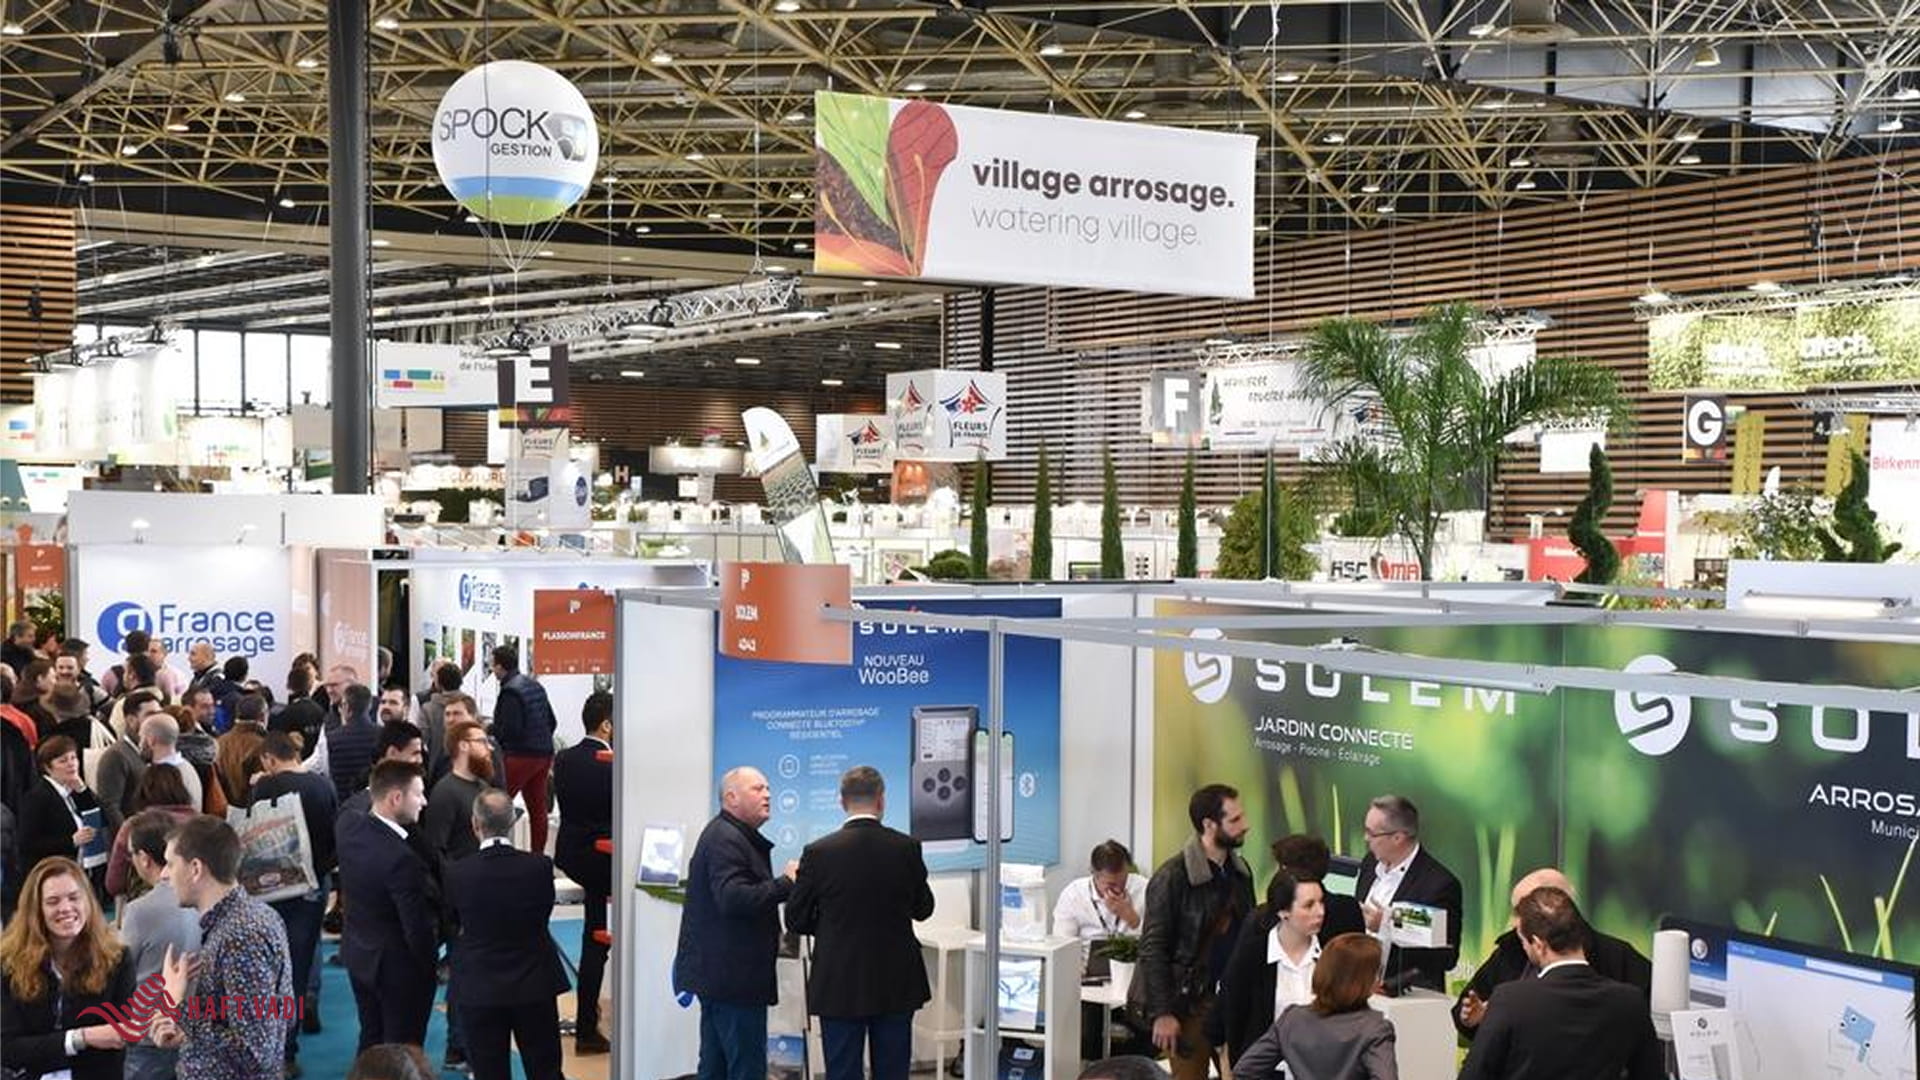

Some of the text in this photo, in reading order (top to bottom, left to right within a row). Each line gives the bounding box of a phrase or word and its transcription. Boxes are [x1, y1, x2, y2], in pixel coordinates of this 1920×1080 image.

[440, 107, 550, 141] SPOCK
[491, 143, 552, 157] GESTION
[973, 159, 1235, 212] village arrosage.
[971, 204, 1202, 250] watering village.
[514, 346, 554, 403] E
[1163, 377, 1190, 429] F
[953, 421, 988, 431] FLEURS
[1687, 399, 1724, 446] G
[614, 465, 629, 483] H
[159, 603, 275, 633] France
[858, 667, 930, 685] WooBee
[863, 654, 925, 668] NOUVEAU
[1255, 716, 1316, 739] JARDIN
[1254, 736, 1292, 753] Arrosage
[1300, 742, 1331, 759] Piscine
[1808, 783, 1920, 817] ARROS
